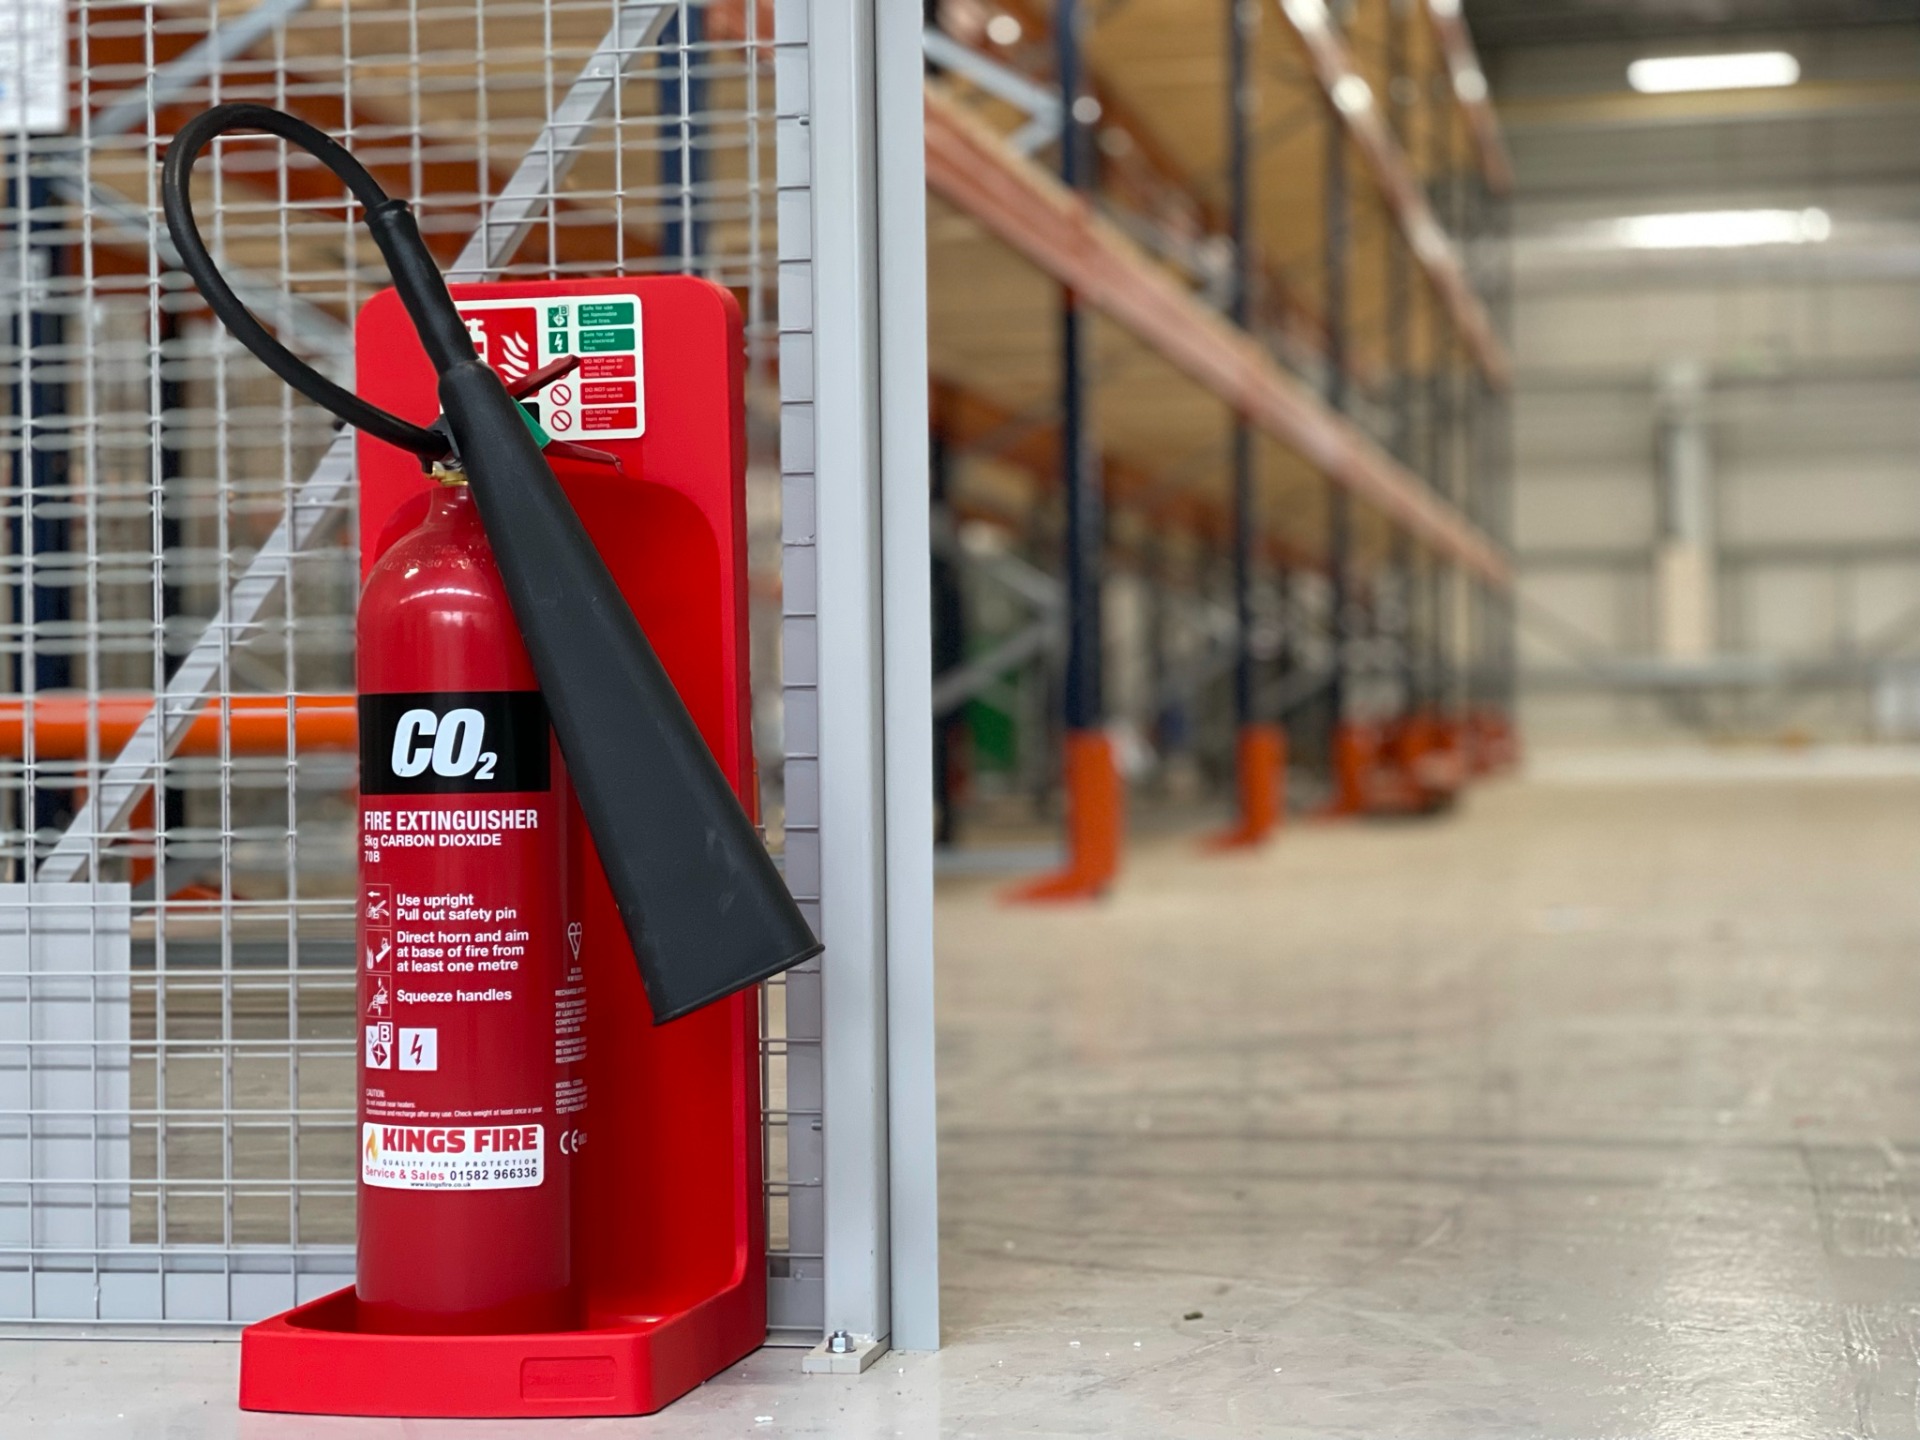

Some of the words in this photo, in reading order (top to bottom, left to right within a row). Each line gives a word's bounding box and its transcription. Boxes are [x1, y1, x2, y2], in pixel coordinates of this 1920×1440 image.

[560, 306, 568, 314] B
[364, 811, 392, 830] FIRE
[396, 810, 538, 830] EXTINGUISHER
[364, 834, 378, 849] 5kg
[380, 834, 434, 847] CARBON
[439, 833, 502, 846] DIOXIDE
[364, 851, 380, 862] 70B
[396, 894, 420, 906] Use
[424, 894, 474, 908] upright
[396, 908, 419, 920] Pull
[422, 909, 446, 920] out
[448, 908, 492, 922] safety
[496, 907, 516, 922] pin
[396, 931, 435, 943] Direct
[438, 930, 471, 943] horn
[474, 930, 502, 942] and
[505, 930, 529, 942] aim
[396, 946, 408, 958] at
[411, 946, 444, 958] base
[447, 945, 462, 957] of
[465, 945, 489, 957] fire
[492, 945, 524, 956] from
[396, 961, 409, 972] at
[411, 960, 444, 972] least
[447, 962, 474, 972] one
[478, 960, 518, 971] metre
[396, 990, 453, 1004] Squeeze
[456, 989, 512, 1001] handles
[380, 1024, 390, 1042] B
[382, 1127, 466, 1154] KINGS
[474, 1126, 538, 1153] FIRE
[383, 1158, 424, 1167] QUALITY
[465, 1158, 538, 1168] PROTECTION
[365, 1165, 396, 1179] Service
[399, 1169, 407, 1179] &
[410, 1169, 446, 1181] Sales
[450, 1170, 490, 1181] 01582
[494, 1167, 538, 1180] 966336
